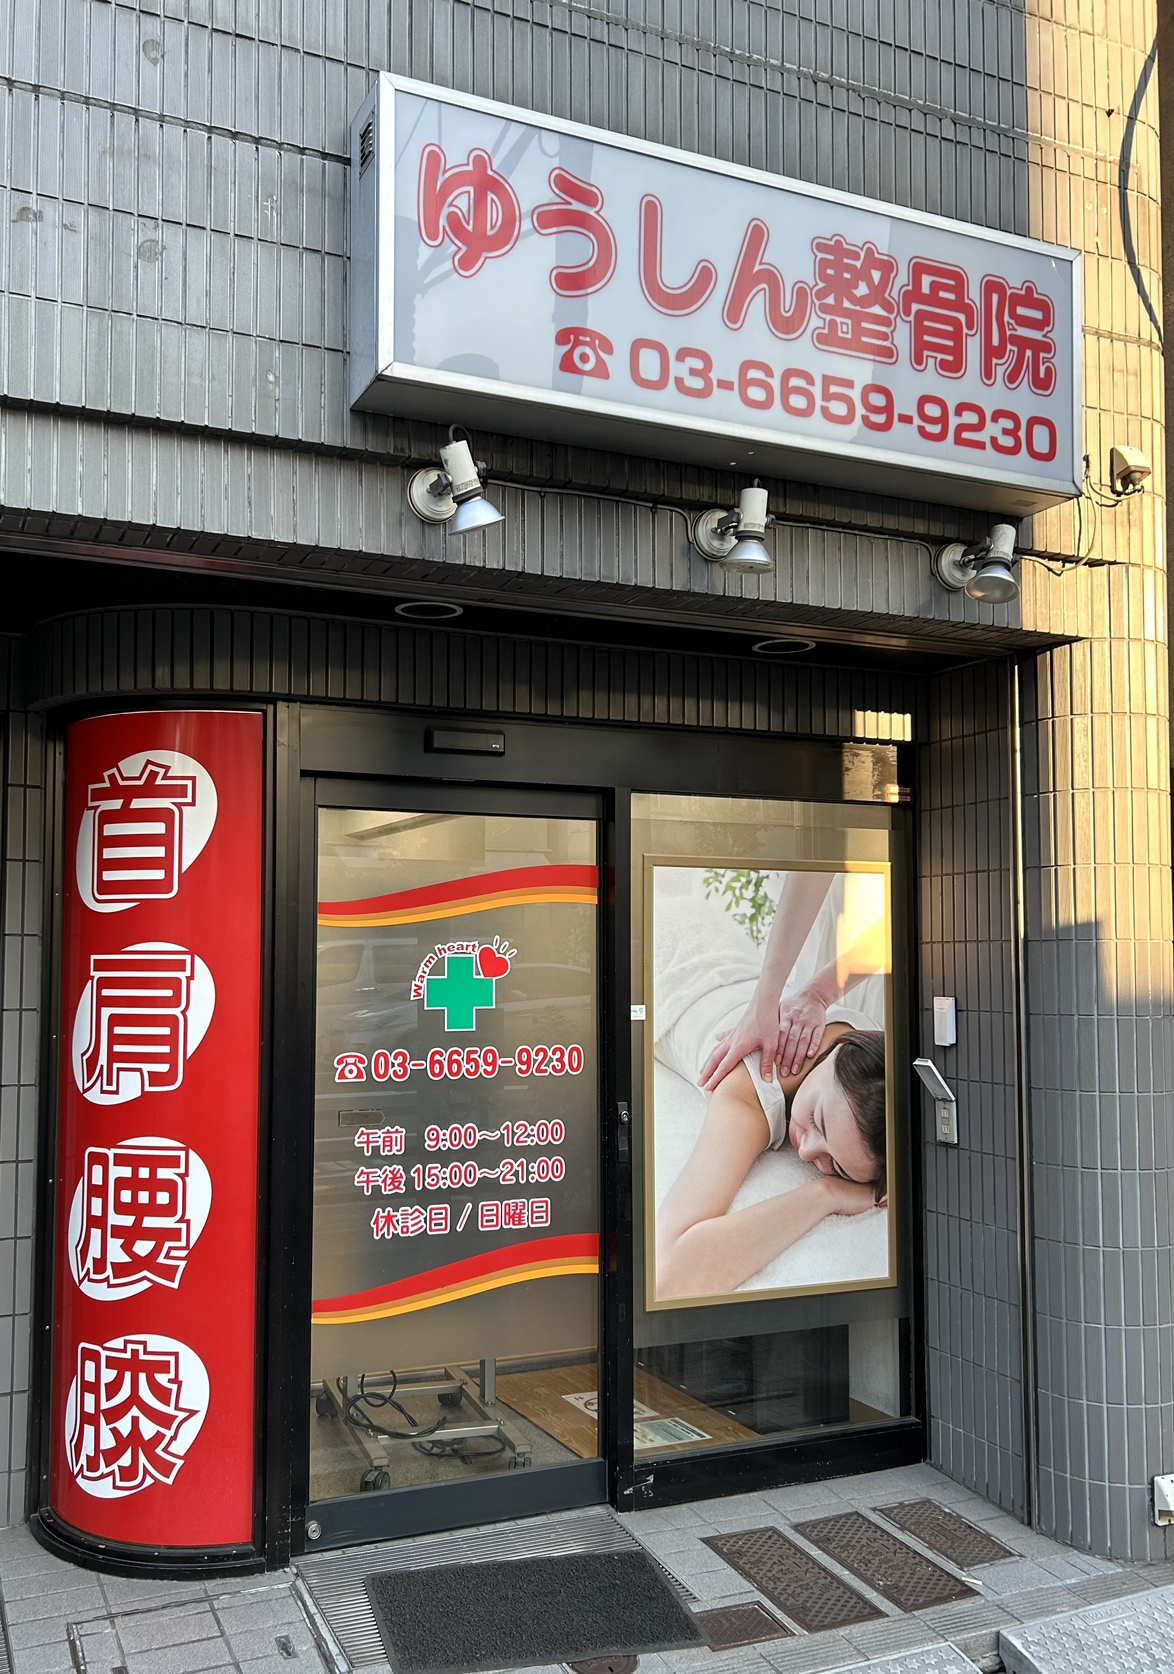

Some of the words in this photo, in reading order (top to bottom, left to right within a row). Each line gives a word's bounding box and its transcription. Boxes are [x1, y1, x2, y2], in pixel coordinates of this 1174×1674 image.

[418, 143, 1056, 396] ゆうしん整骨院
[630, 338, 1058, 463] 03-6659-9230
[412, 954, 437, 999] Warm
[436, 942, 478, 957] heart
[371, 1045, 584, 1081] 03-6659-9230
[355, 1127, 405, 1156] 午前
[355, 1165, 405, 1195] 午後
[371, 1204, 450, 1239] 休診日
[479, 1198, 550, 1231] 日曜日
